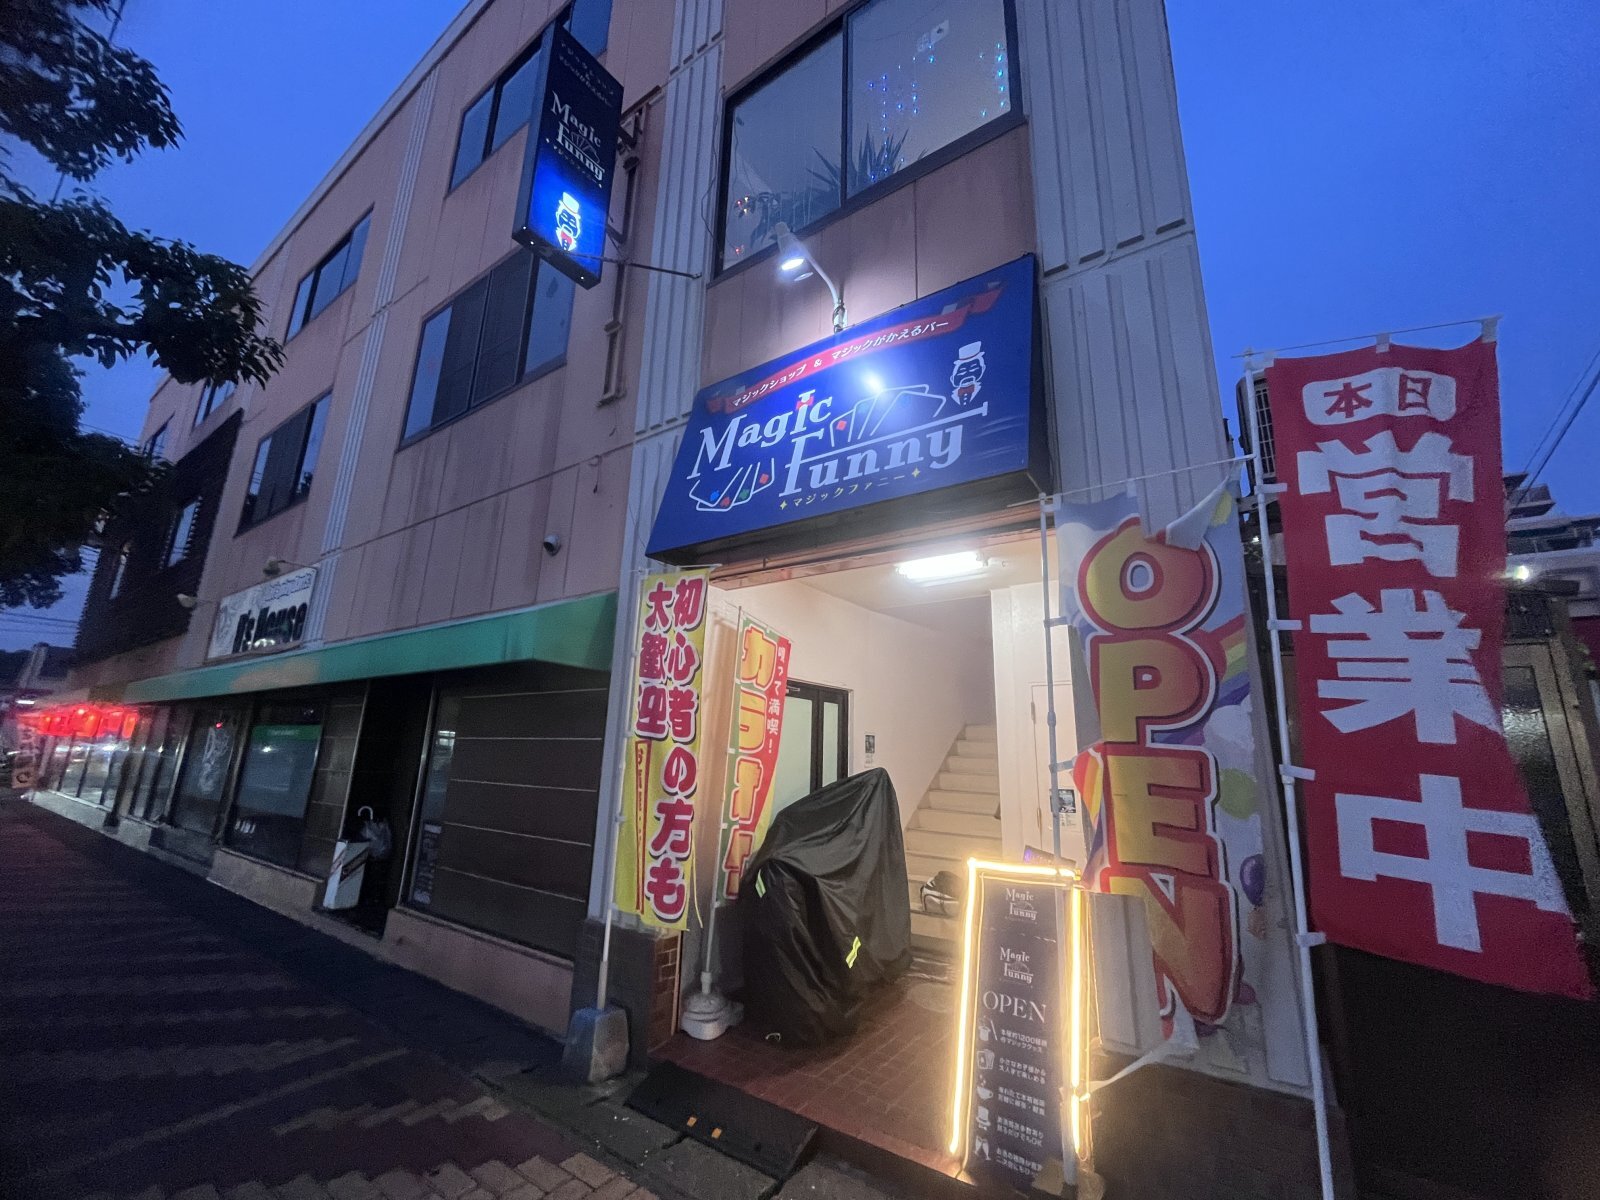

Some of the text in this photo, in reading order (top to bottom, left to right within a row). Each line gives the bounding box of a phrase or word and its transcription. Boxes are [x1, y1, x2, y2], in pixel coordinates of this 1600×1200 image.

[551, 90, 601, 148] Magic
[556, 121, 605, 181] Funny
[732, 363, 807, 407] マジックショップ
[813, 358, 823, 368] &
[686, 389, 833, 480] Magic
[778, 401, 989, 499] Funny
[793, 474, 905, 507] マジックファニー
[635, 582, 672, 742] 大歓迎
[1296, 431, 1572, 954] 営業中
[648, 577, 704, 918] 初心者の方も
[1076, 515, 1237, 1025] OPEN
[1006, 887, 1034, 901] Magic
[1009, 902, 1038, 920] Funny
[1000, 946, 1030, 962] Magic
[1003, 962, 1034, 984] Funny
[983, 990, 1046, 1023] OPEN
